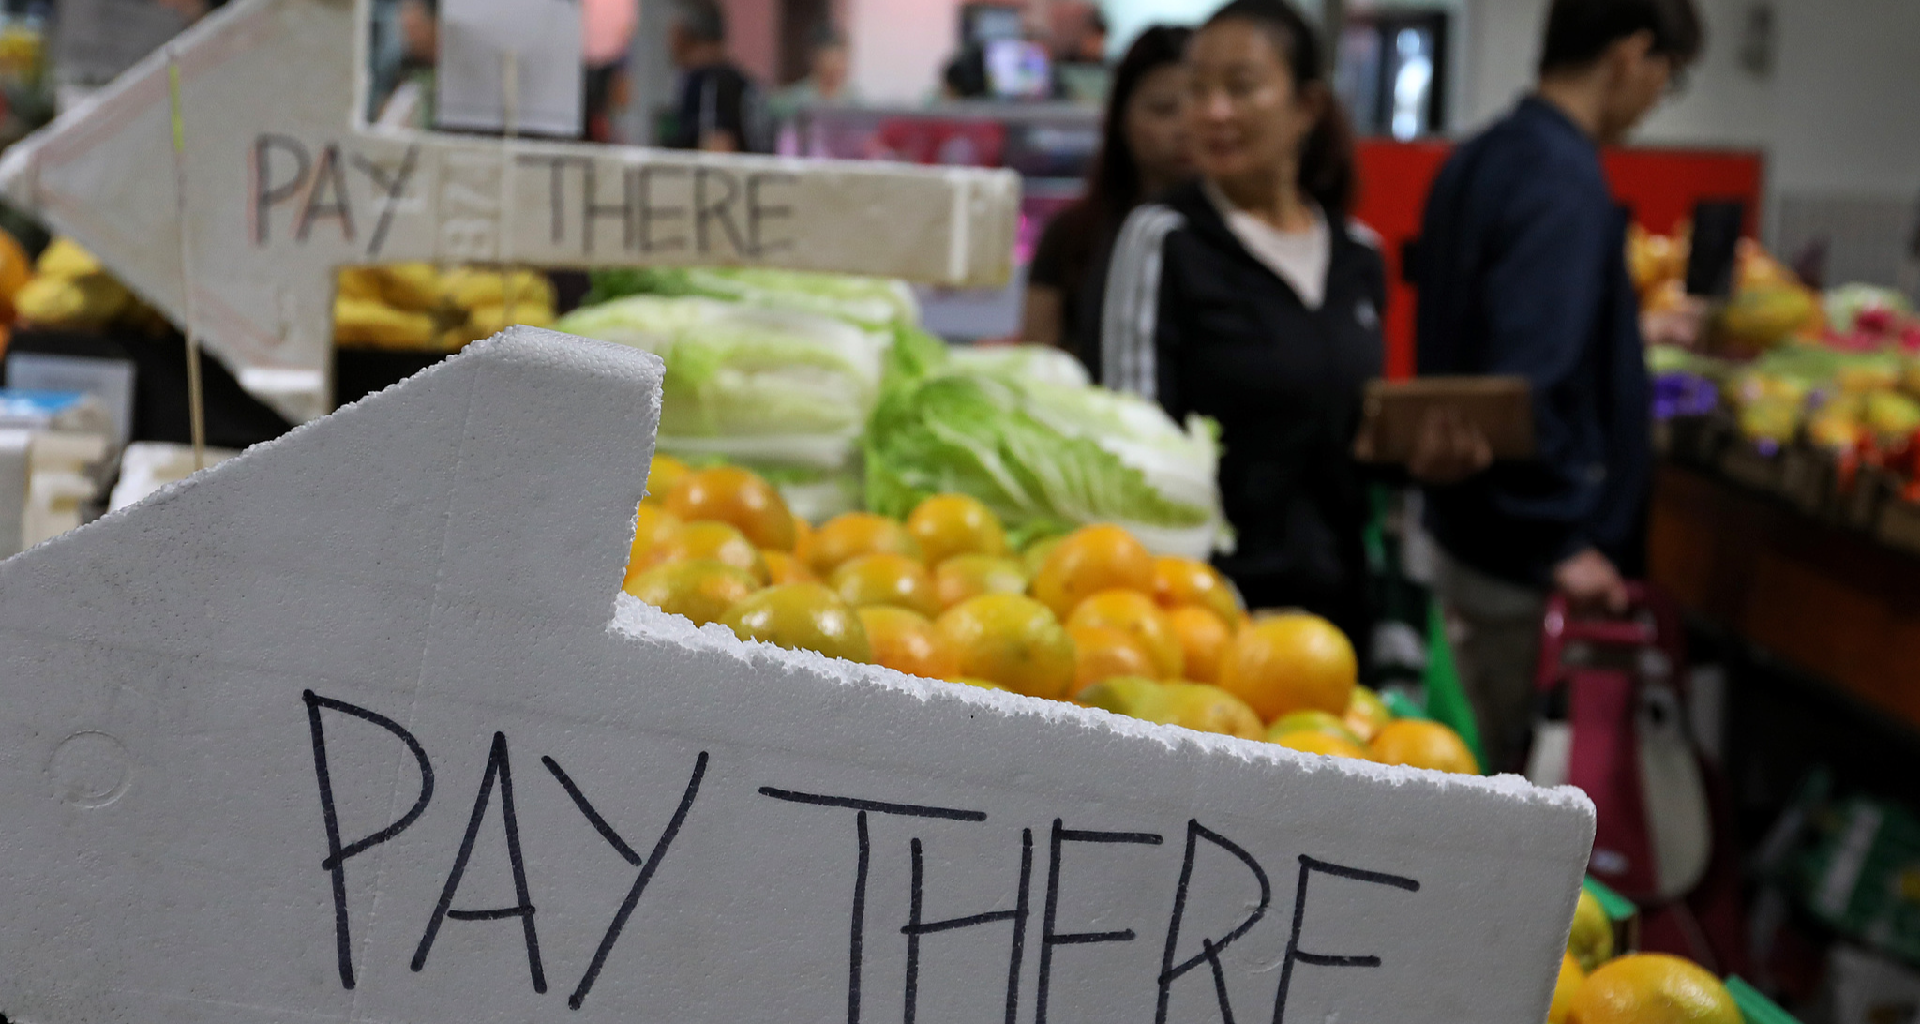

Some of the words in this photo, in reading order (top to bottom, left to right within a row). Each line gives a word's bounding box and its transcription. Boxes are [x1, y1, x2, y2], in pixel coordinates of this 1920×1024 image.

[250, 133, 420, 255] PAY
[515, 153, 799, 258] THERE
[302, 689, 709, 1010] PAY
[758, 786, 1420, 1024] THERE
